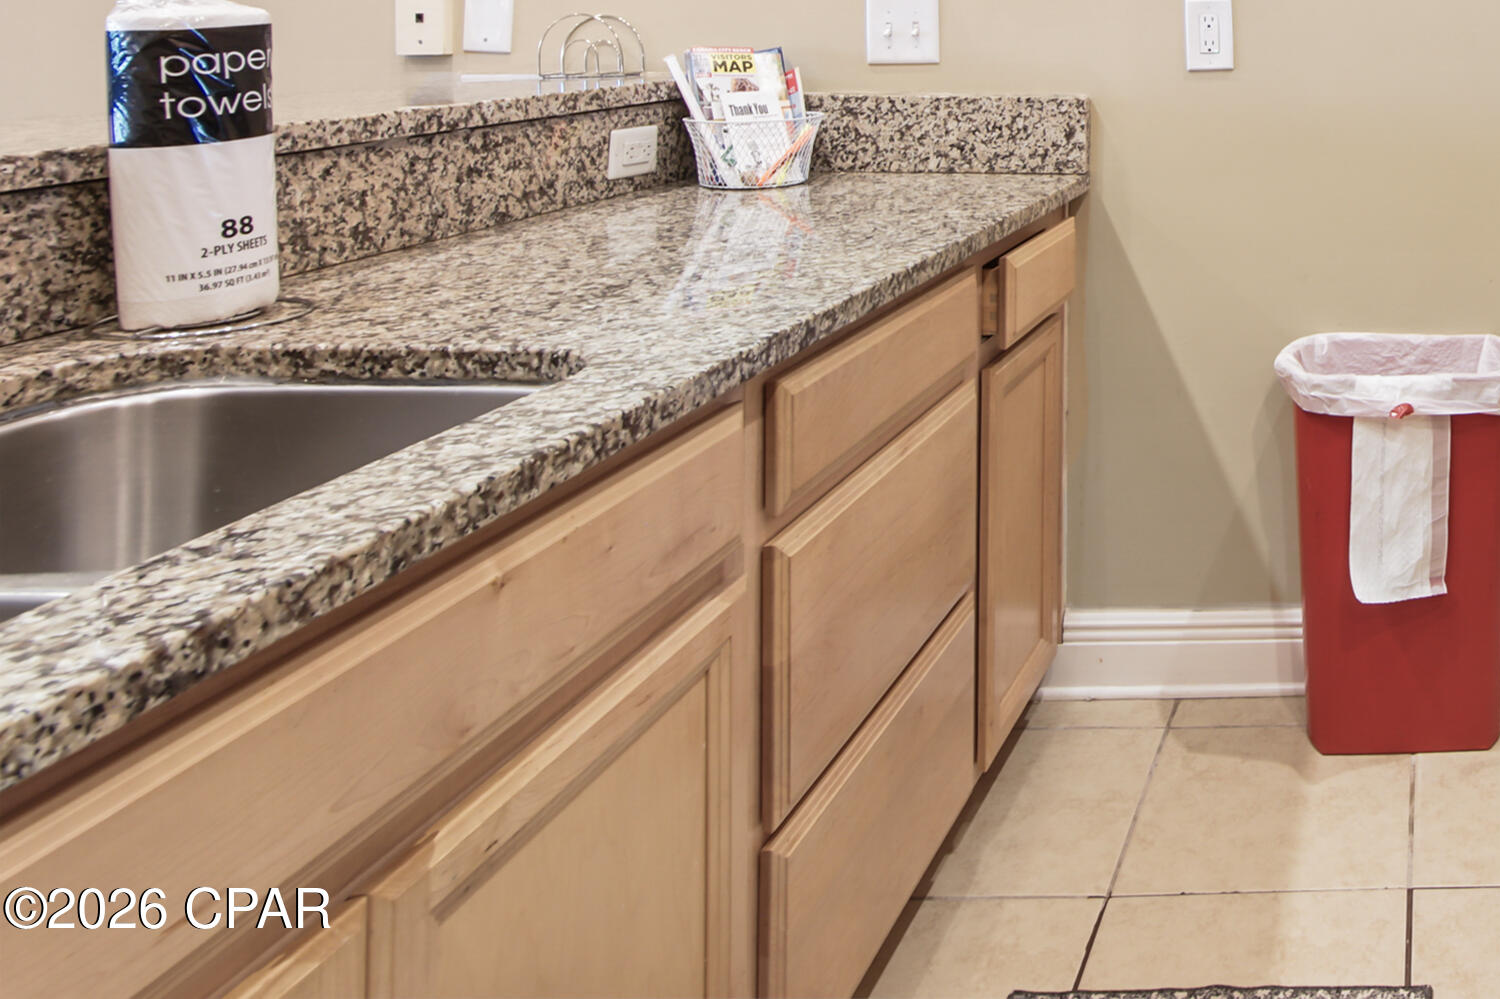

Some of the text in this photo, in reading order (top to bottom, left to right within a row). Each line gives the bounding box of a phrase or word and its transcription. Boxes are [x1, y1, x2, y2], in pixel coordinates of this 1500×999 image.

[713, 60, 753, 73] MAP
[729, 104, 753, 116] Thank
[753, 103, 768, 114] You
[221, 215, 254, 239] 88
[201, 235, 267, 259] 2-PLY SHEETS
[178, 273, 188, 281] IN
[198, 270, 211, 279] 5.5
[225, 279, 235, 288] SQ
[236, 276, 244, 284] FT
